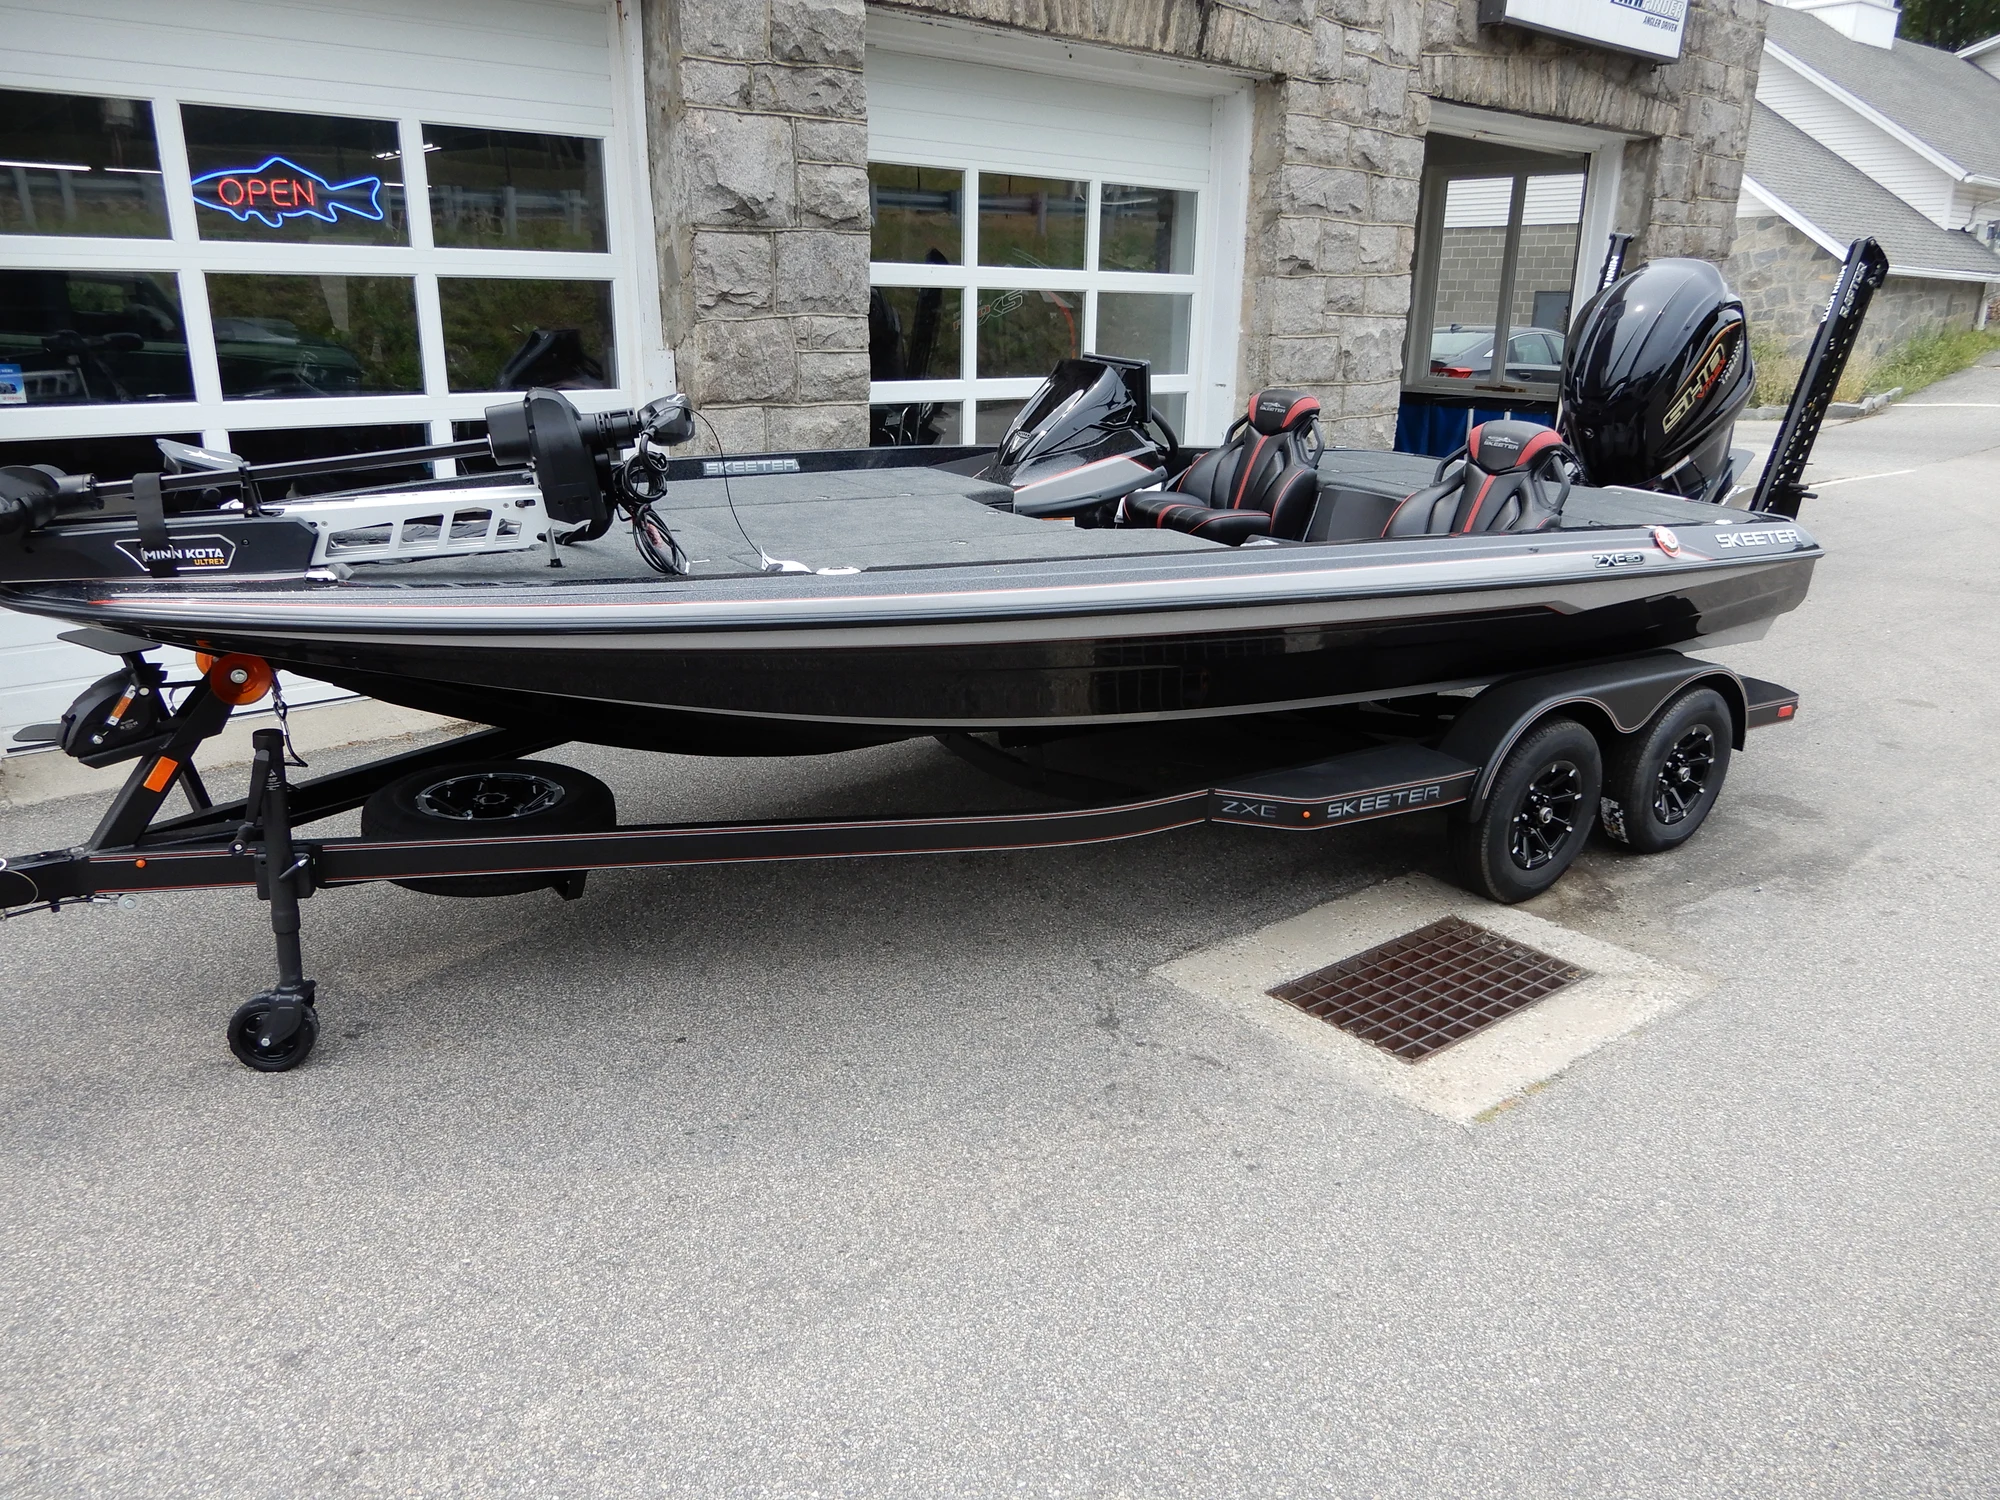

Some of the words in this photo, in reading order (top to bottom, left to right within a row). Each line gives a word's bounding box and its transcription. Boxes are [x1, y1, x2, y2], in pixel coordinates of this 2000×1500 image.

[218, 178, 315, 206] OPEN
[1839, 261, 1867, 319] RAPTOR
[1662, 343, 1726, 434] SHO
[705, 460, 800, 474] SKEETER
[1714, 529, 1802, 549] SKEETER
[143, 549, 183, 560] MINN
[185, 548, 224, 559] KOTA
[193, 558, 225, 566] ULTREX
[1221, 800, 1278, 819] ZXE
[1327, 786, 1441, 819] SKEETER
